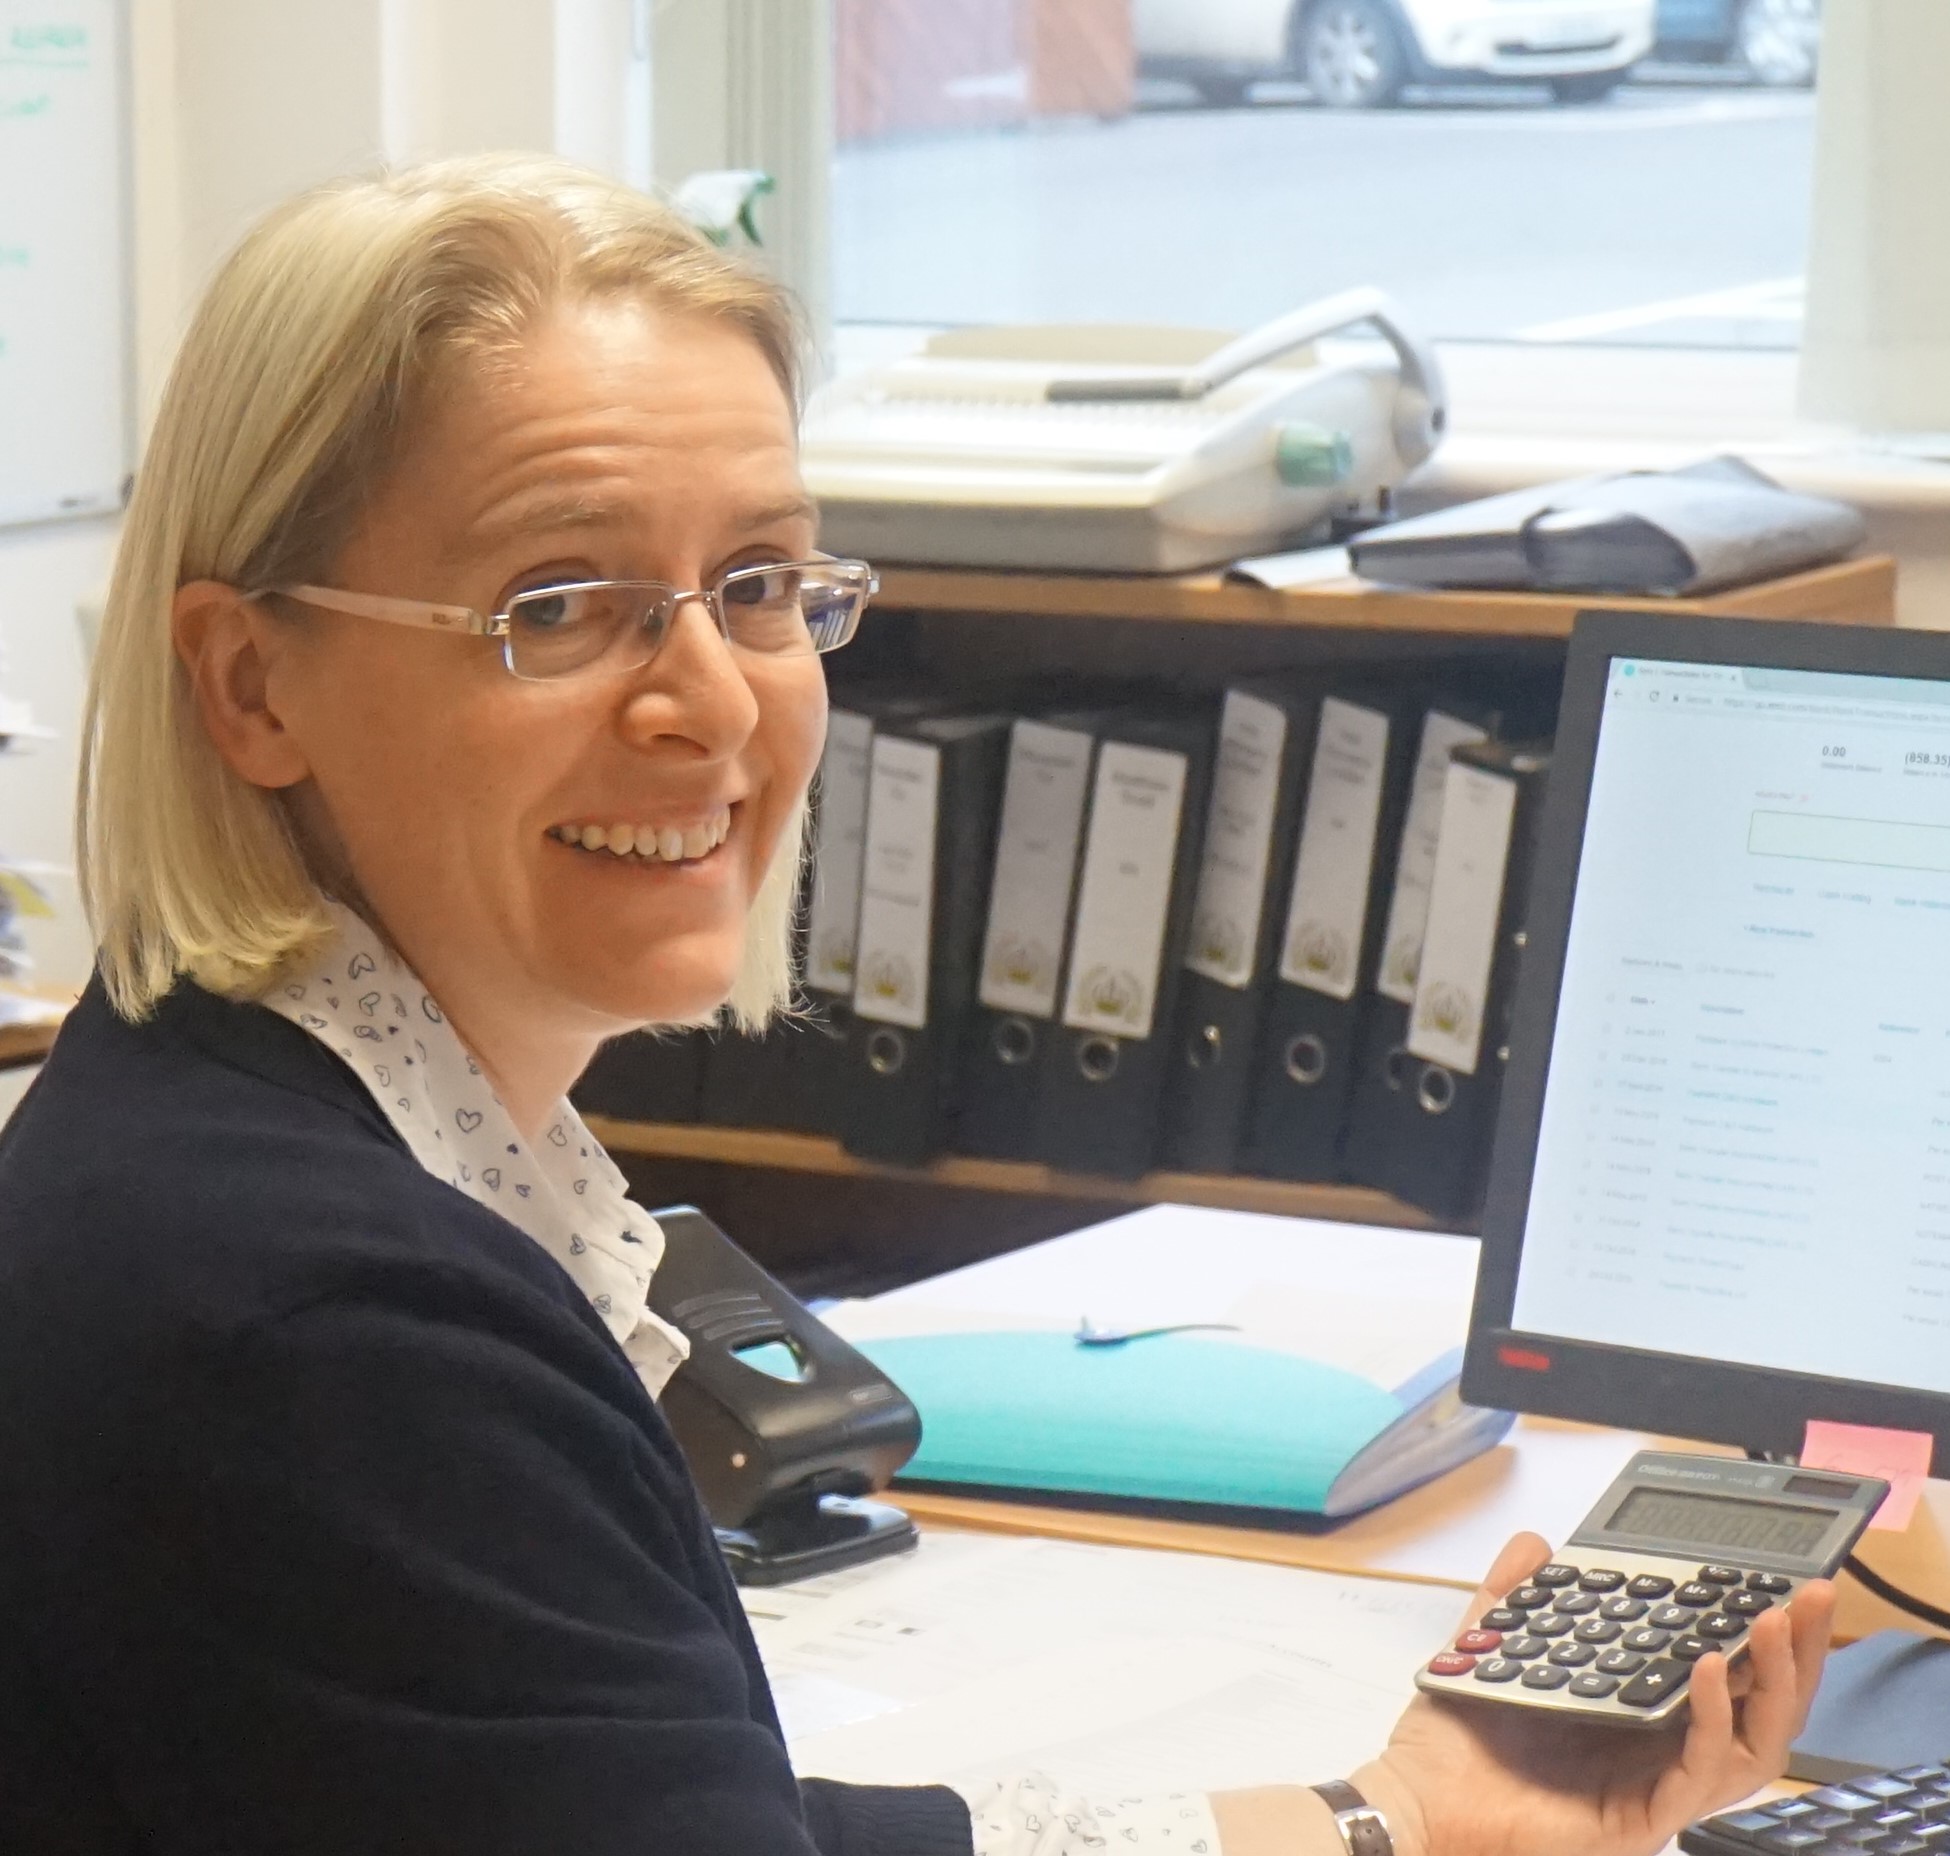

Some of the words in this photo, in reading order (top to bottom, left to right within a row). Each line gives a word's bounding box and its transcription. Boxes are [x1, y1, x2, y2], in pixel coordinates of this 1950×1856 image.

[1822, 745, 1847, 758] 0.00
[1543, 1566, 1569, 1577] SET
[1585, 1571, 1615, 1582] MRC
[1567, 1593, 1585, 1605] 7
[1613, 1600, 1630, 1612] 8
[1663, 1608, 1680, 1620] 9
[1541, 1615, 1558, 1628] 4
[1587, 1621, 1605, 1633] 5
[1636, 1630, 1653, 1642] 6
[1516, 1638, 1529, 1650] 1
[1559, 1645, 1578, 1657] 2
[1608, 1652, 1626, 1665] 3
[1488, 1660, 1505, 1672] 0
